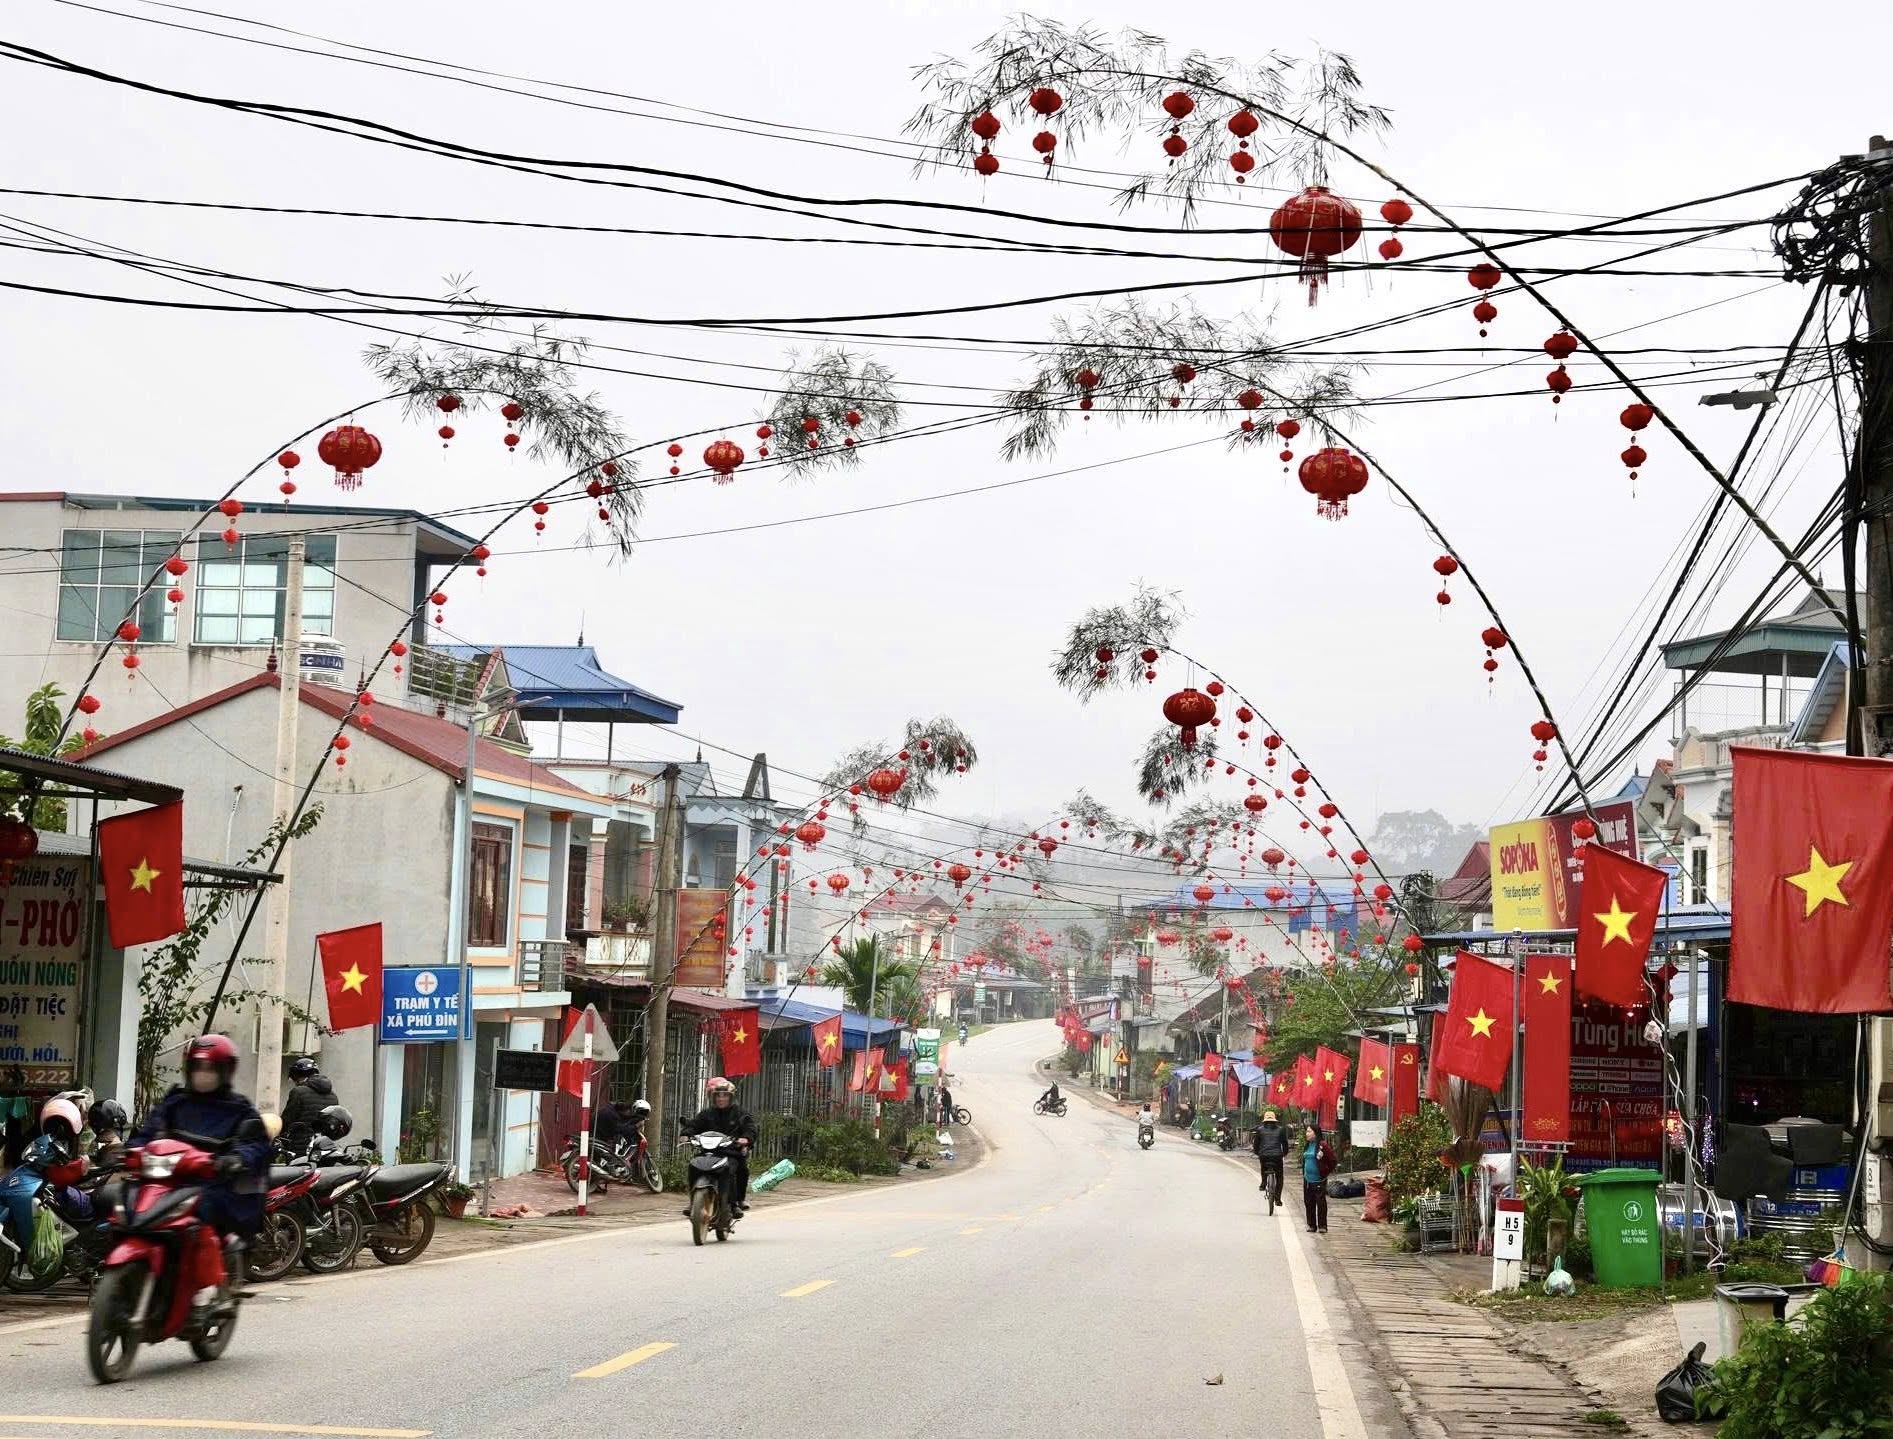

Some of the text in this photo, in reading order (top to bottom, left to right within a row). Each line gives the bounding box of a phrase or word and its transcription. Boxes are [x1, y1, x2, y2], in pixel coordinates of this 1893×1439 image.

[35, 956, 77, 987] NÓNG
[36, 992, 66, 1021] TIỆC
[394, 993, 459, 1012] TRẠM Y TẾ
[387, 1011, 458, 1028] XÃ PHÚ ĐÌN
[1571, 1016, 1619, 1053] Tùng
[1505, 1217, 1519, 1229] H 5
[1508, 1234, 1514, 1246] 9
